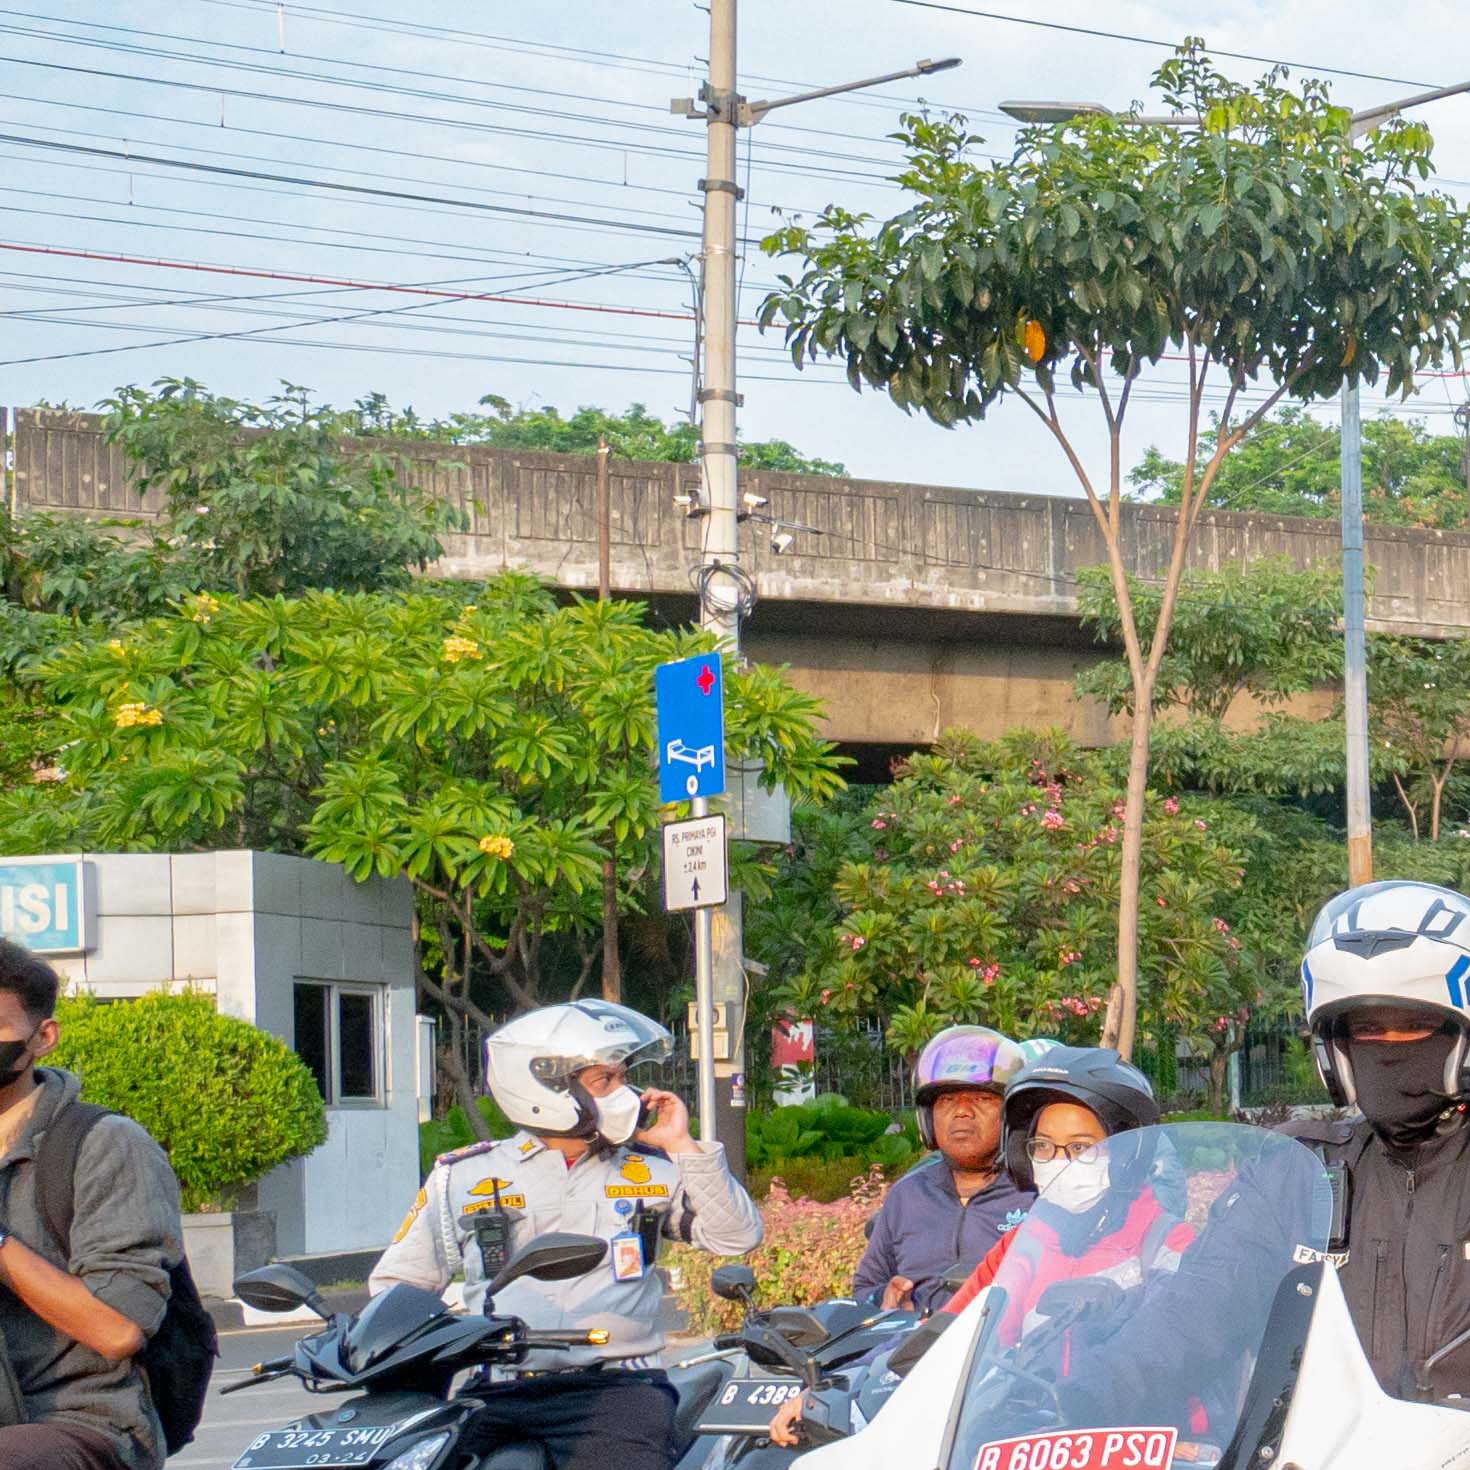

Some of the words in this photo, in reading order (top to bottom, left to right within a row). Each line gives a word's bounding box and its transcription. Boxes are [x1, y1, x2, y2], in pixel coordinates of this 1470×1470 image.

[720, 1384, 739, 1405] B
[250, 1433, 272, 1451] B
[276, 1431, 337, 1449] 3245
[340, 1428, 393, 1446] SMU
[1100, 1432, 1168, 1468] PSQ
